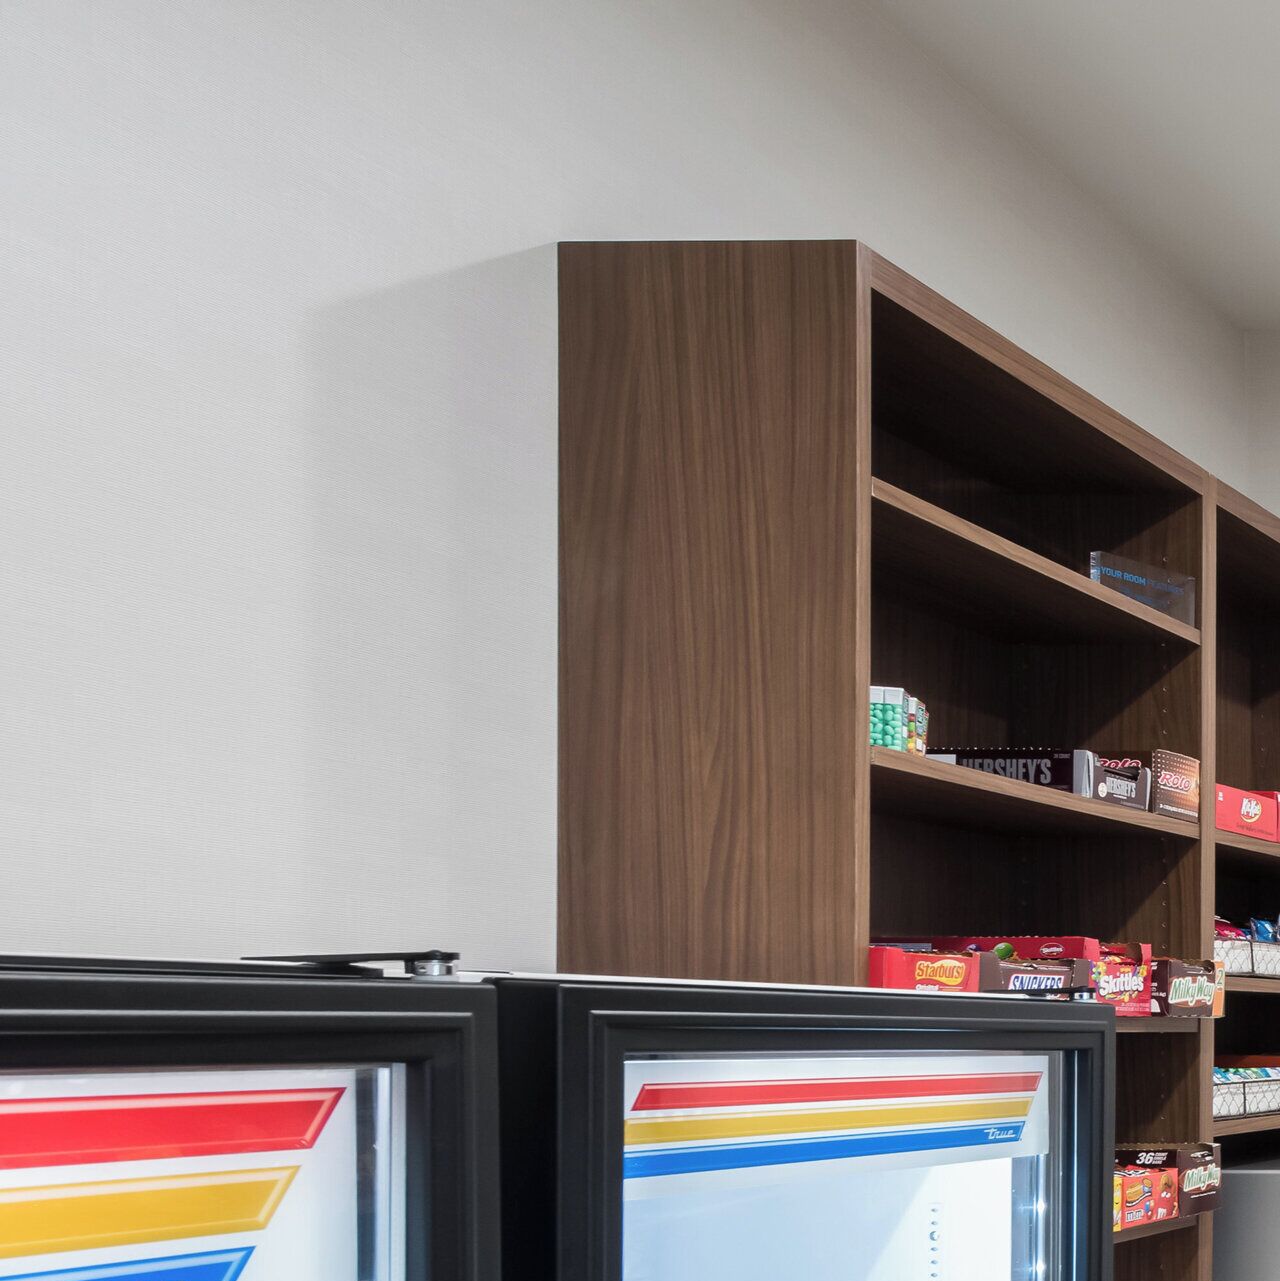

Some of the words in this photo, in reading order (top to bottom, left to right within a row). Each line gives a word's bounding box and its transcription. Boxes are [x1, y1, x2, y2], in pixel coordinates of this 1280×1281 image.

[1100, 566, 1122, 580] YOUR
[916, 960, 965, 980] Starburst
[1099, 973, 1144, 995] Skittles
[1136, 1152, 1154, 1164] 36
